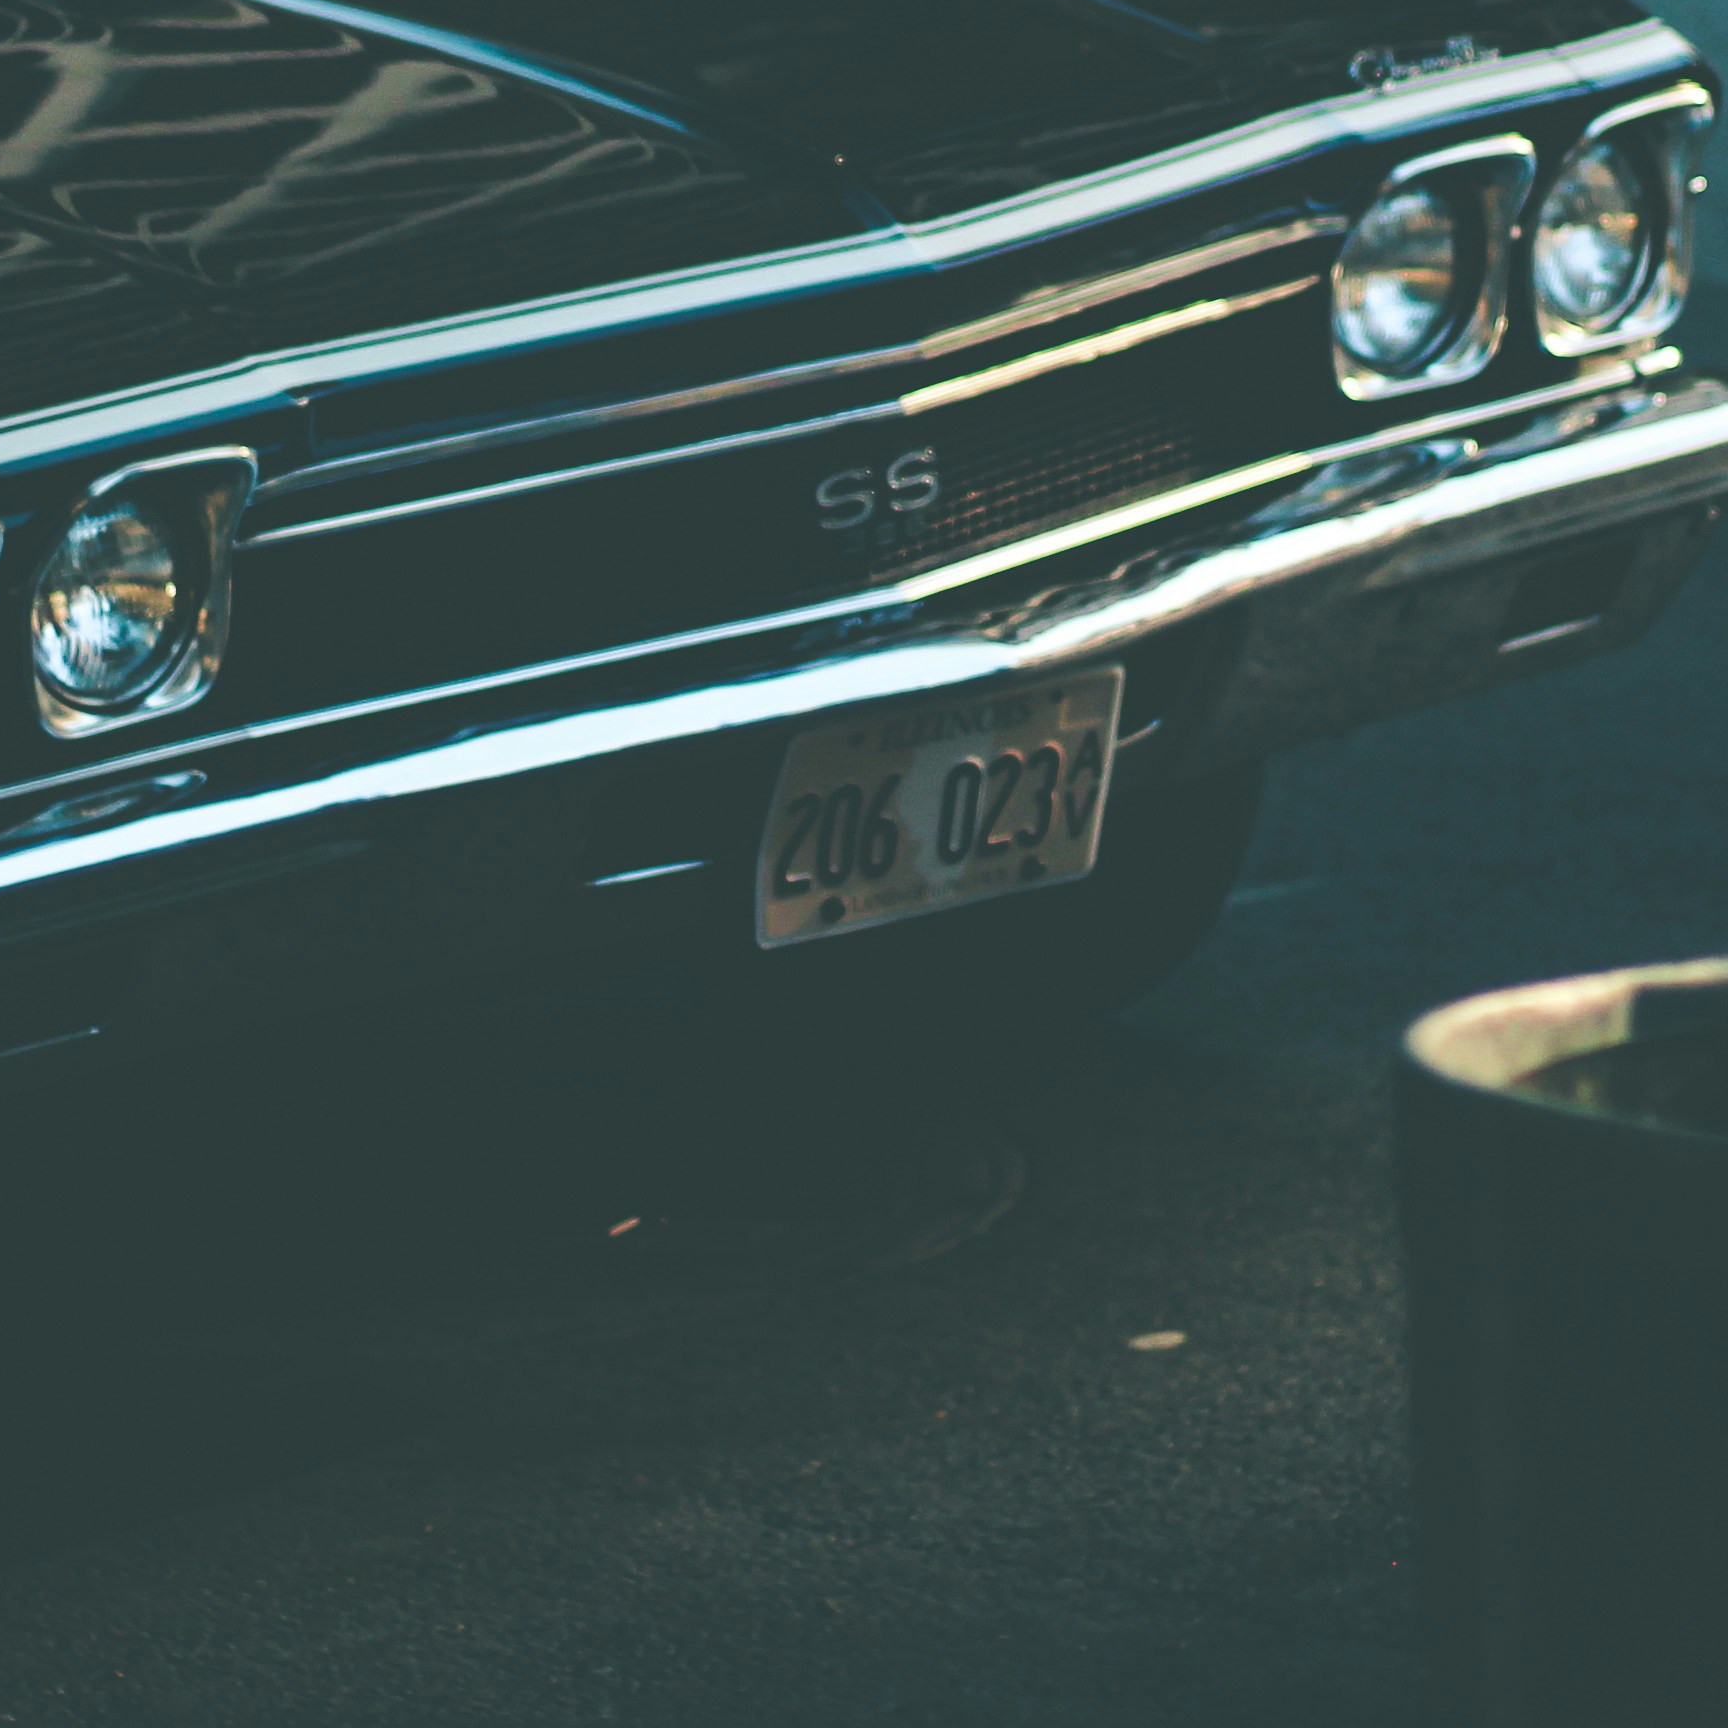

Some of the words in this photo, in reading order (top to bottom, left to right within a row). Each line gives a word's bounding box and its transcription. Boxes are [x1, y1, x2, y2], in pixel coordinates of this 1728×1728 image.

[815, 446, 940, 530] SS
[774, 772, 902, 898] 206
[937, 744, 1062, 866] 023
